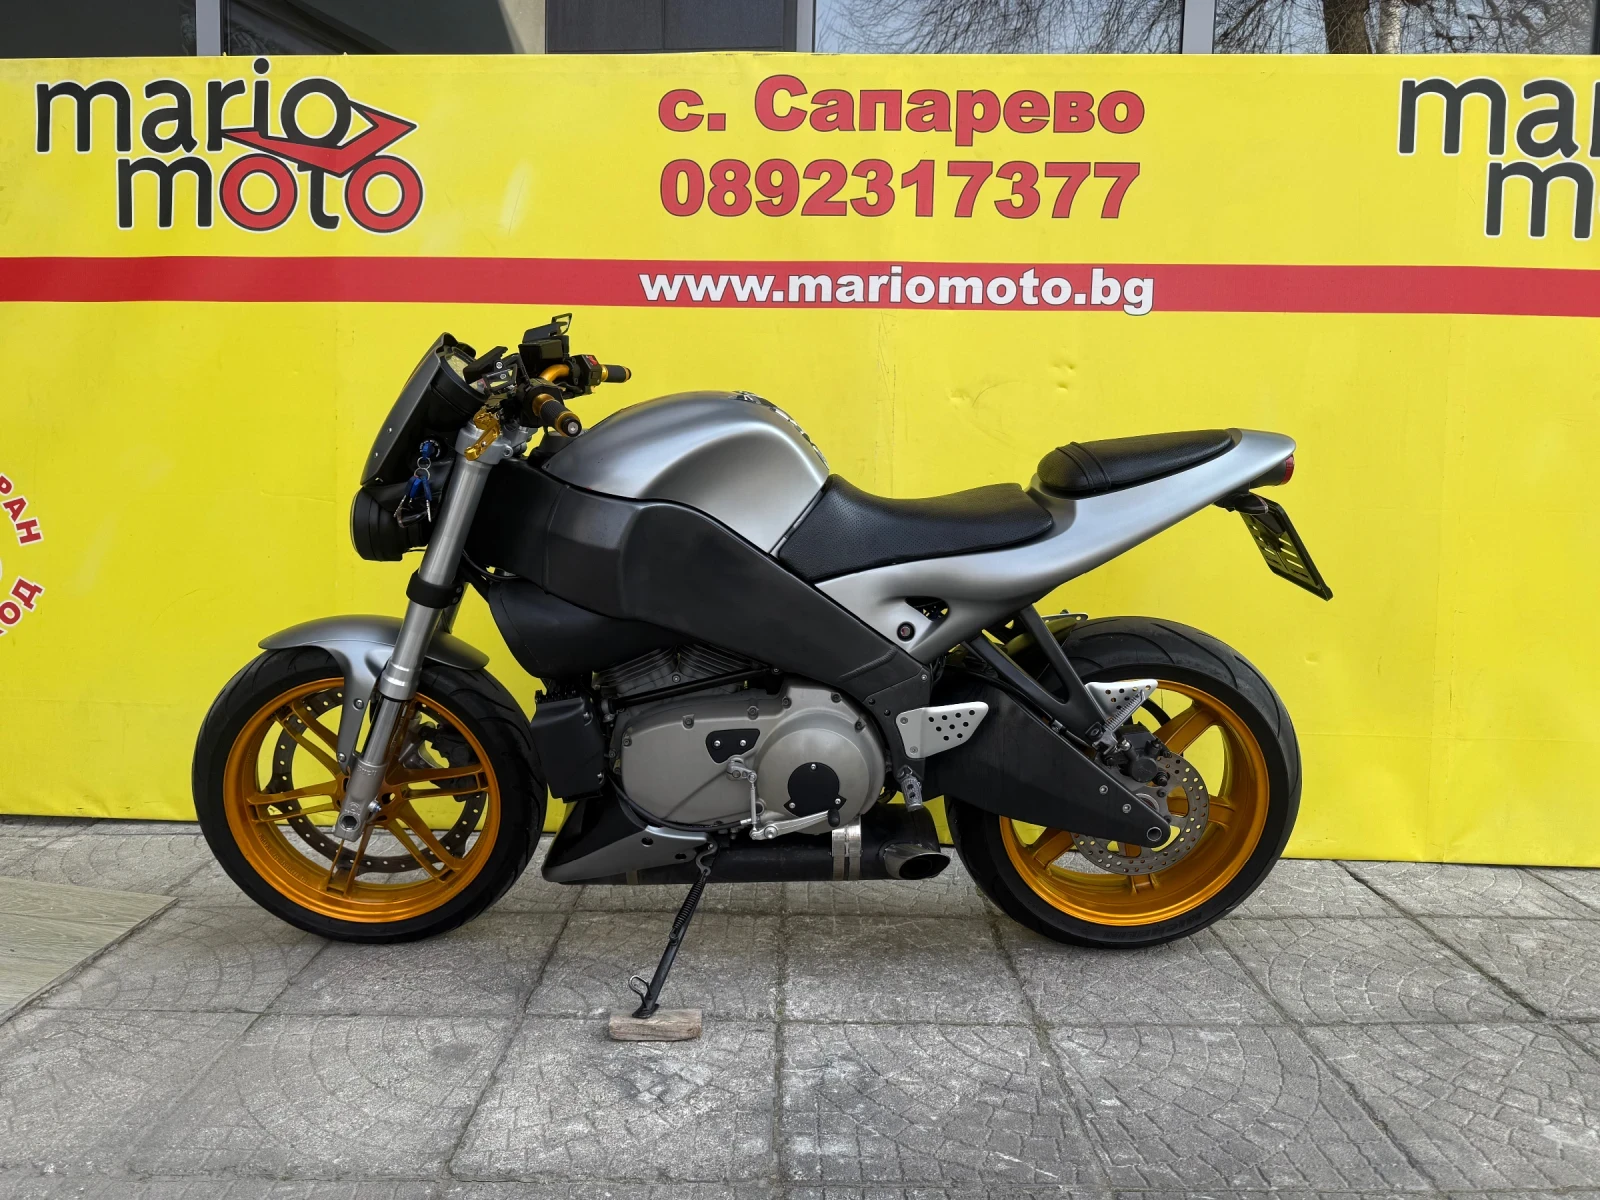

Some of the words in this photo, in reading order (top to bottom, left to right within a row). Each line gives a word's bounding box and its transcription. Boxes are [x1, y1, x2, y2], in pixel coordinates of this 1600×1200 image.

[37, 58, 352, 153] mario
[658, 89, 727, 132] с.
[755, 74, 1145, 146] Сапарево
[118, 154, 423, 232] moto
[660, 158, 1141, 219] 0892317377
[639, 266, 1154, 315] www.mariomoto.bg
[0, 578, 43, 635] ОД
